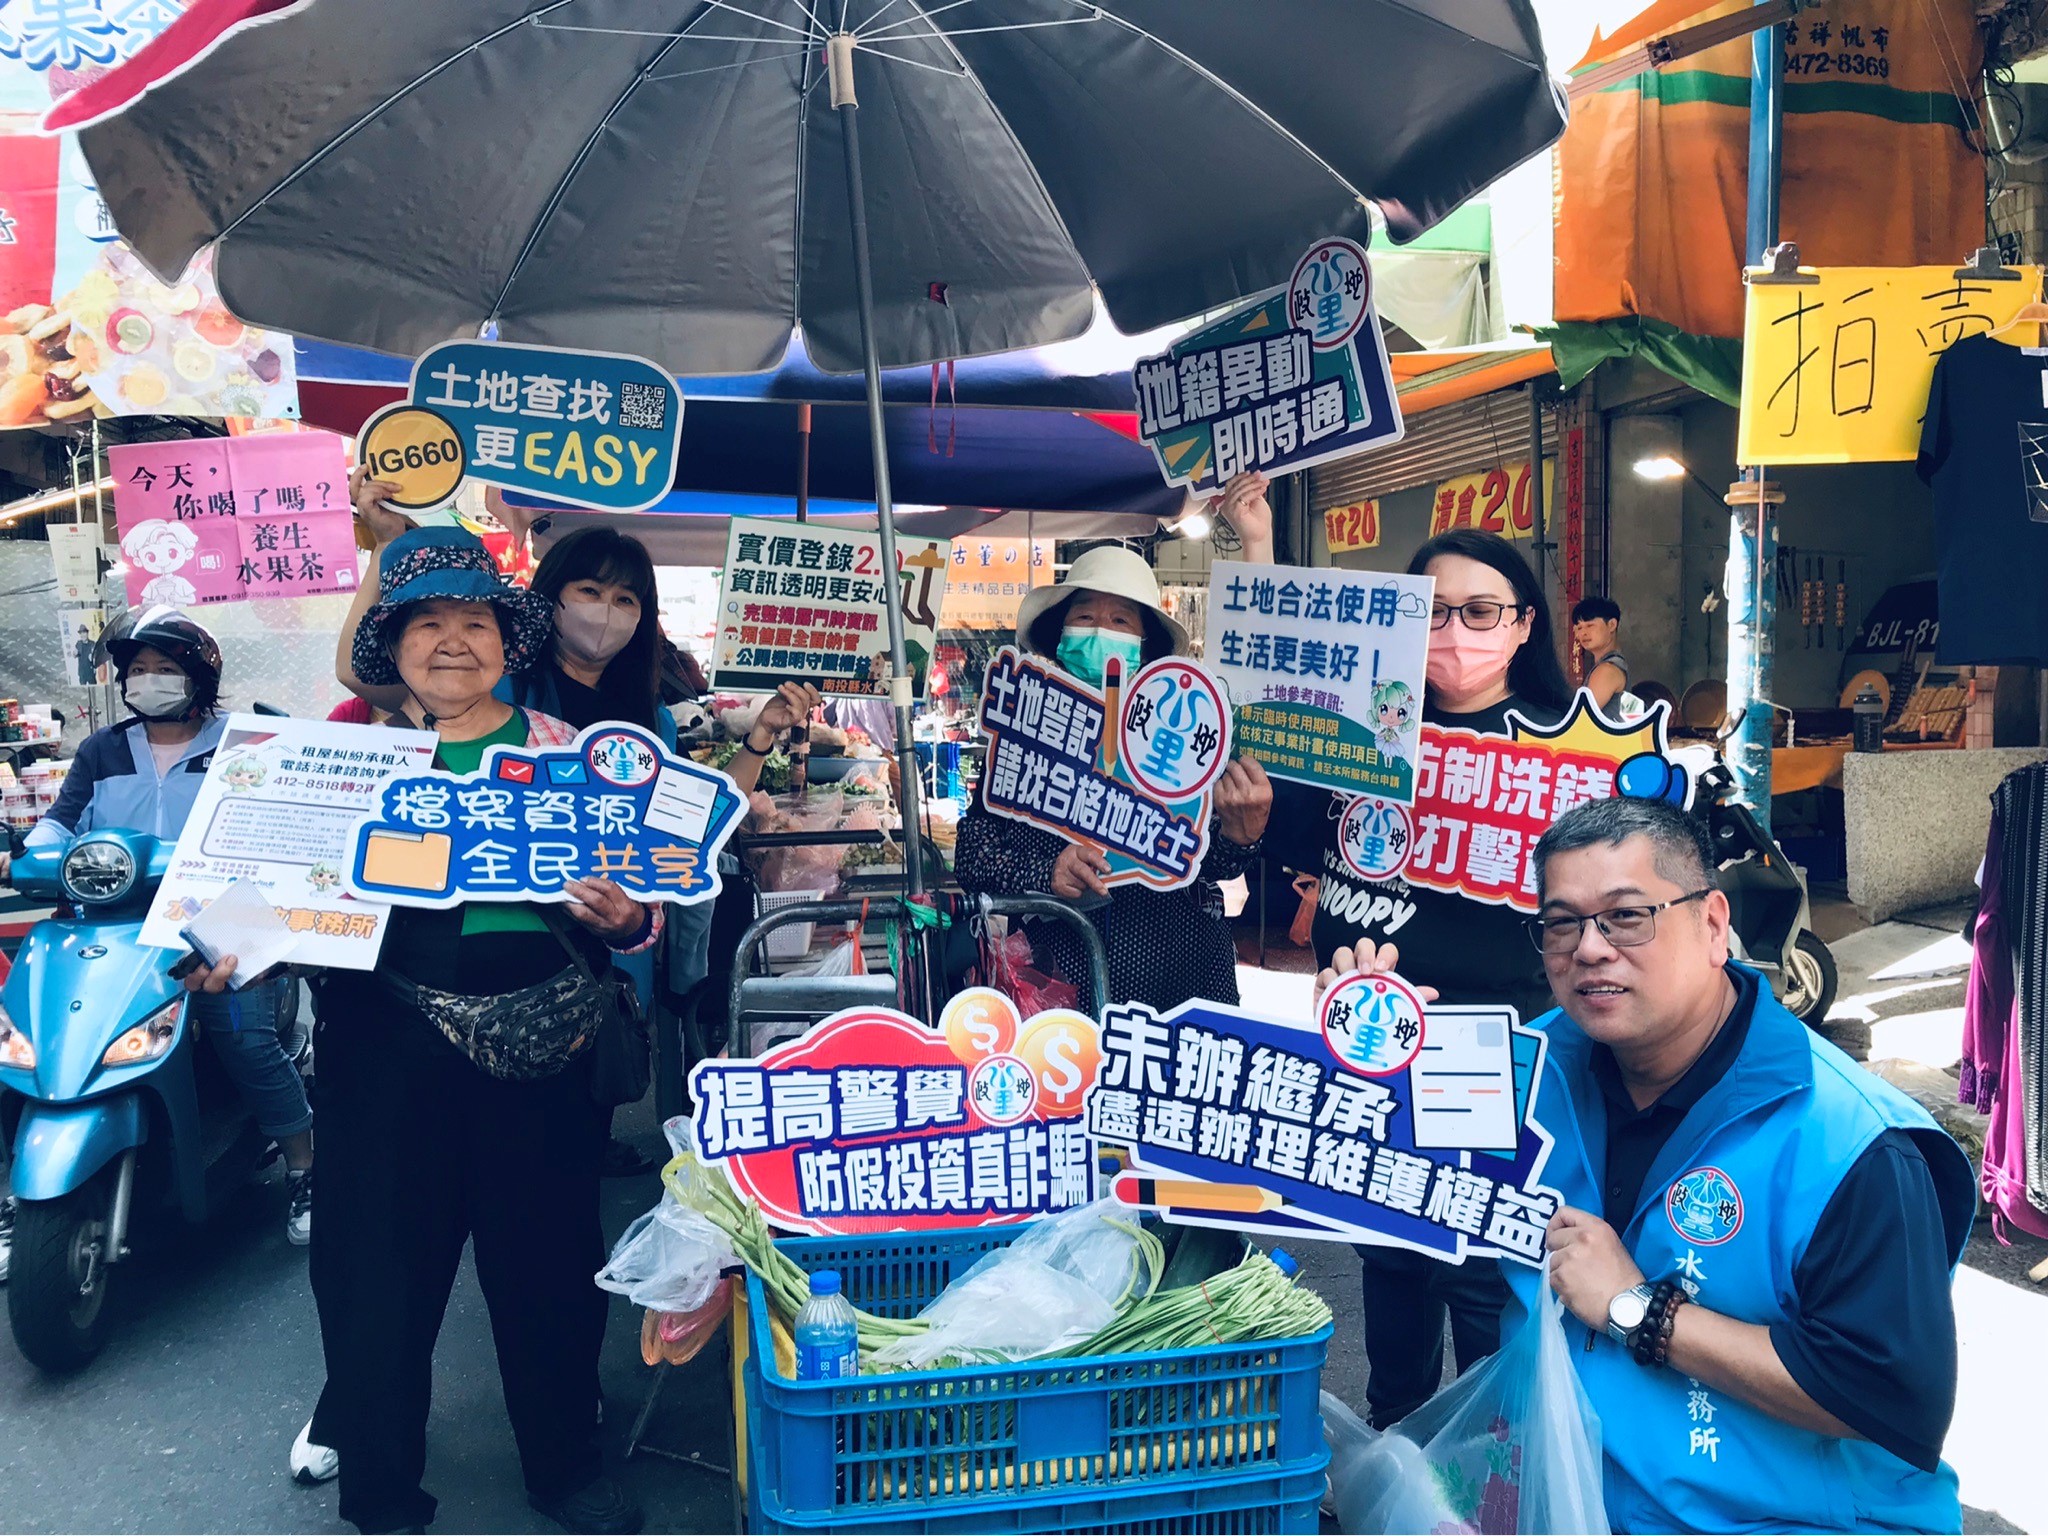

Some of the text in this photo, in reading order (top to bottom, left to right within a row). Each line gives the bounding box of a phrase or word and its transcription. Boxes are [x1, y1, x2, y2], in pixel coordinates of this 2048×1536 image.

[425, 363, 613, 424] 土地查找
[1138, 332, 1311, 435] 地籍異動
[369, 438, 459, 475] IG660
[1213, 381, 1345, 484] 即時通
[236, 553, 325, 586] 水果茶
[251, 522, 312, 552] 養生
[1223, 575, 1397, 627] 土地合法使用
[986, 664, 1102, 764] 土地登記
[392, 785, 640, 836] 檔案資源
[992, 738, 1196, 872] 請找合格地政士
[461, 838, 704, 889] 全民共享
[701, 1070, 964, 1155] 提高警覺
[1105, 1015, 1397, 1141] 未辦繼承
[1090, 1090, 1557, 1258] 儘速辦理維護權益
